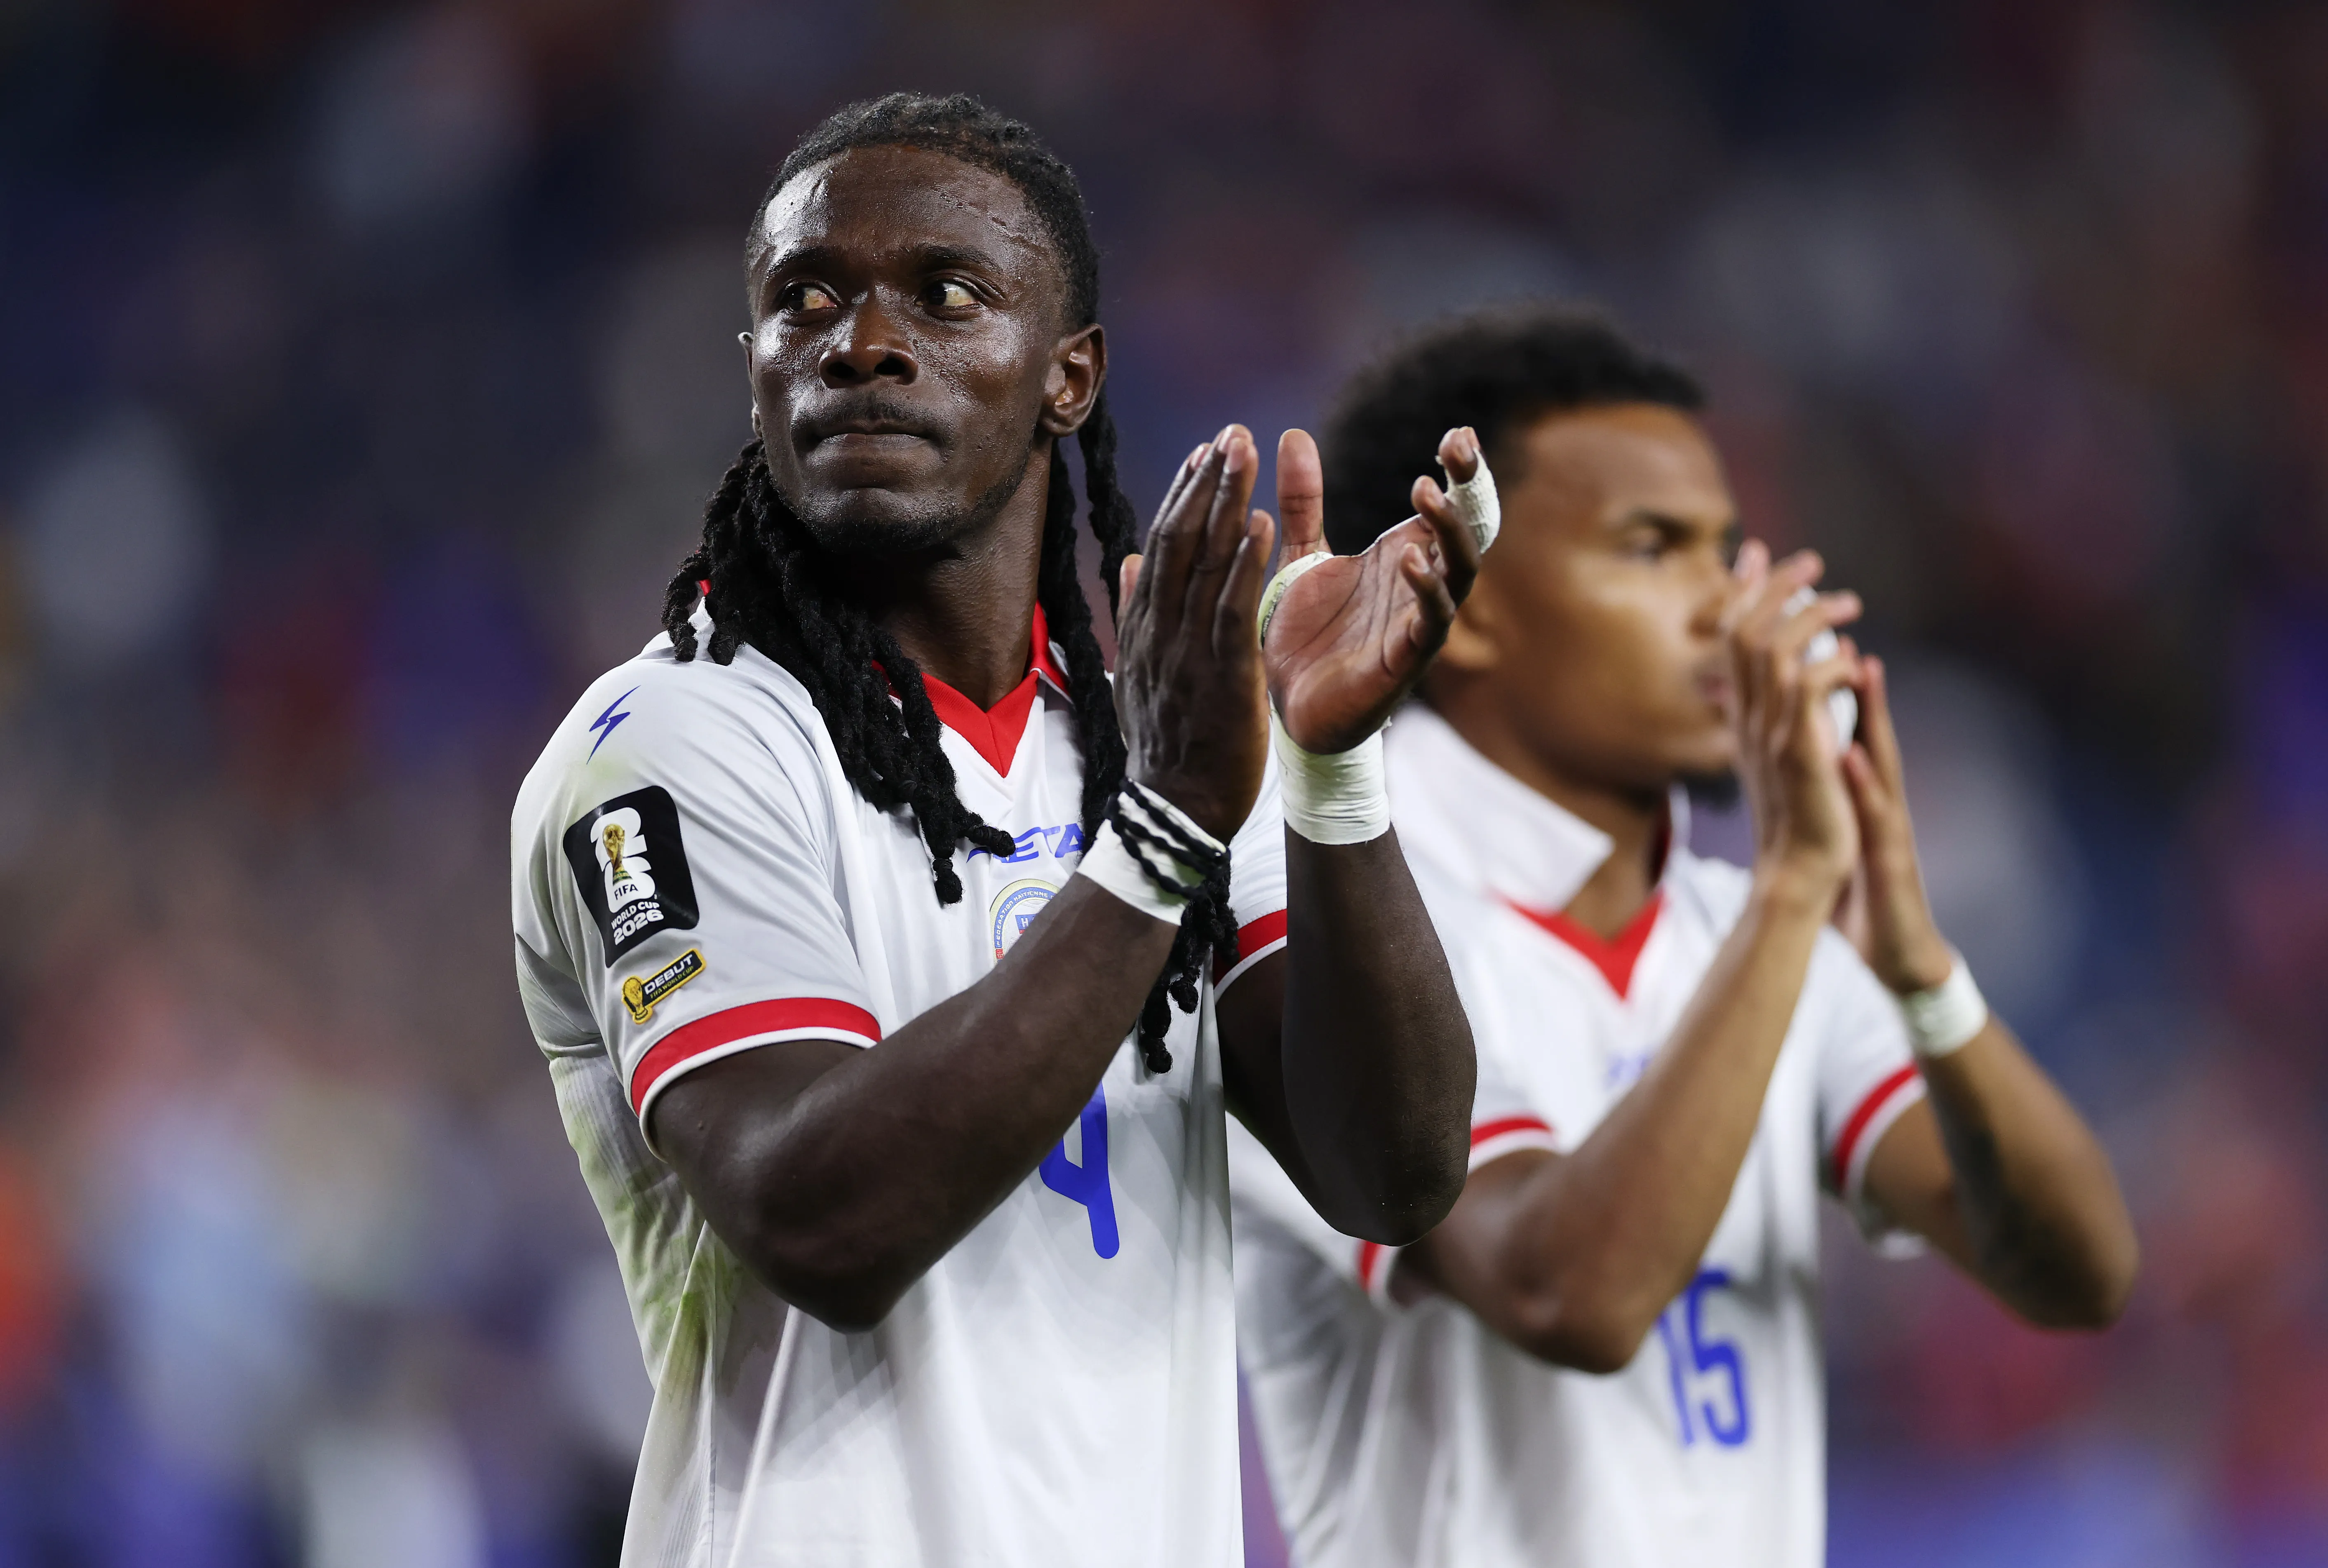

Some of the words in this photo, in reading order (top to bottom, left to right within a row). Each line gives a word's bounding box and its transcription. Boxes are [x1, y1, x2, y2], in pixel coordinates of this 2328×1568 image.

[614, 884, 639, 900] FIFA
[1013, 890, 1048, 902] HAITIENNE
[611, 905, 637, 930] WORLD
[637, 901, 660, 911] CUP
[613, 909, 664, 946] 2026
[644, 954, 693, 995] DEBUT
[650, 988, 662, 999] FIFA
[662, 974, 682, 990] WORLD
[682, 966, 694, 976] CUP
[1038, 1080, 1120, 1259] 4
[1658, 1265, 1750, 1447] 15
